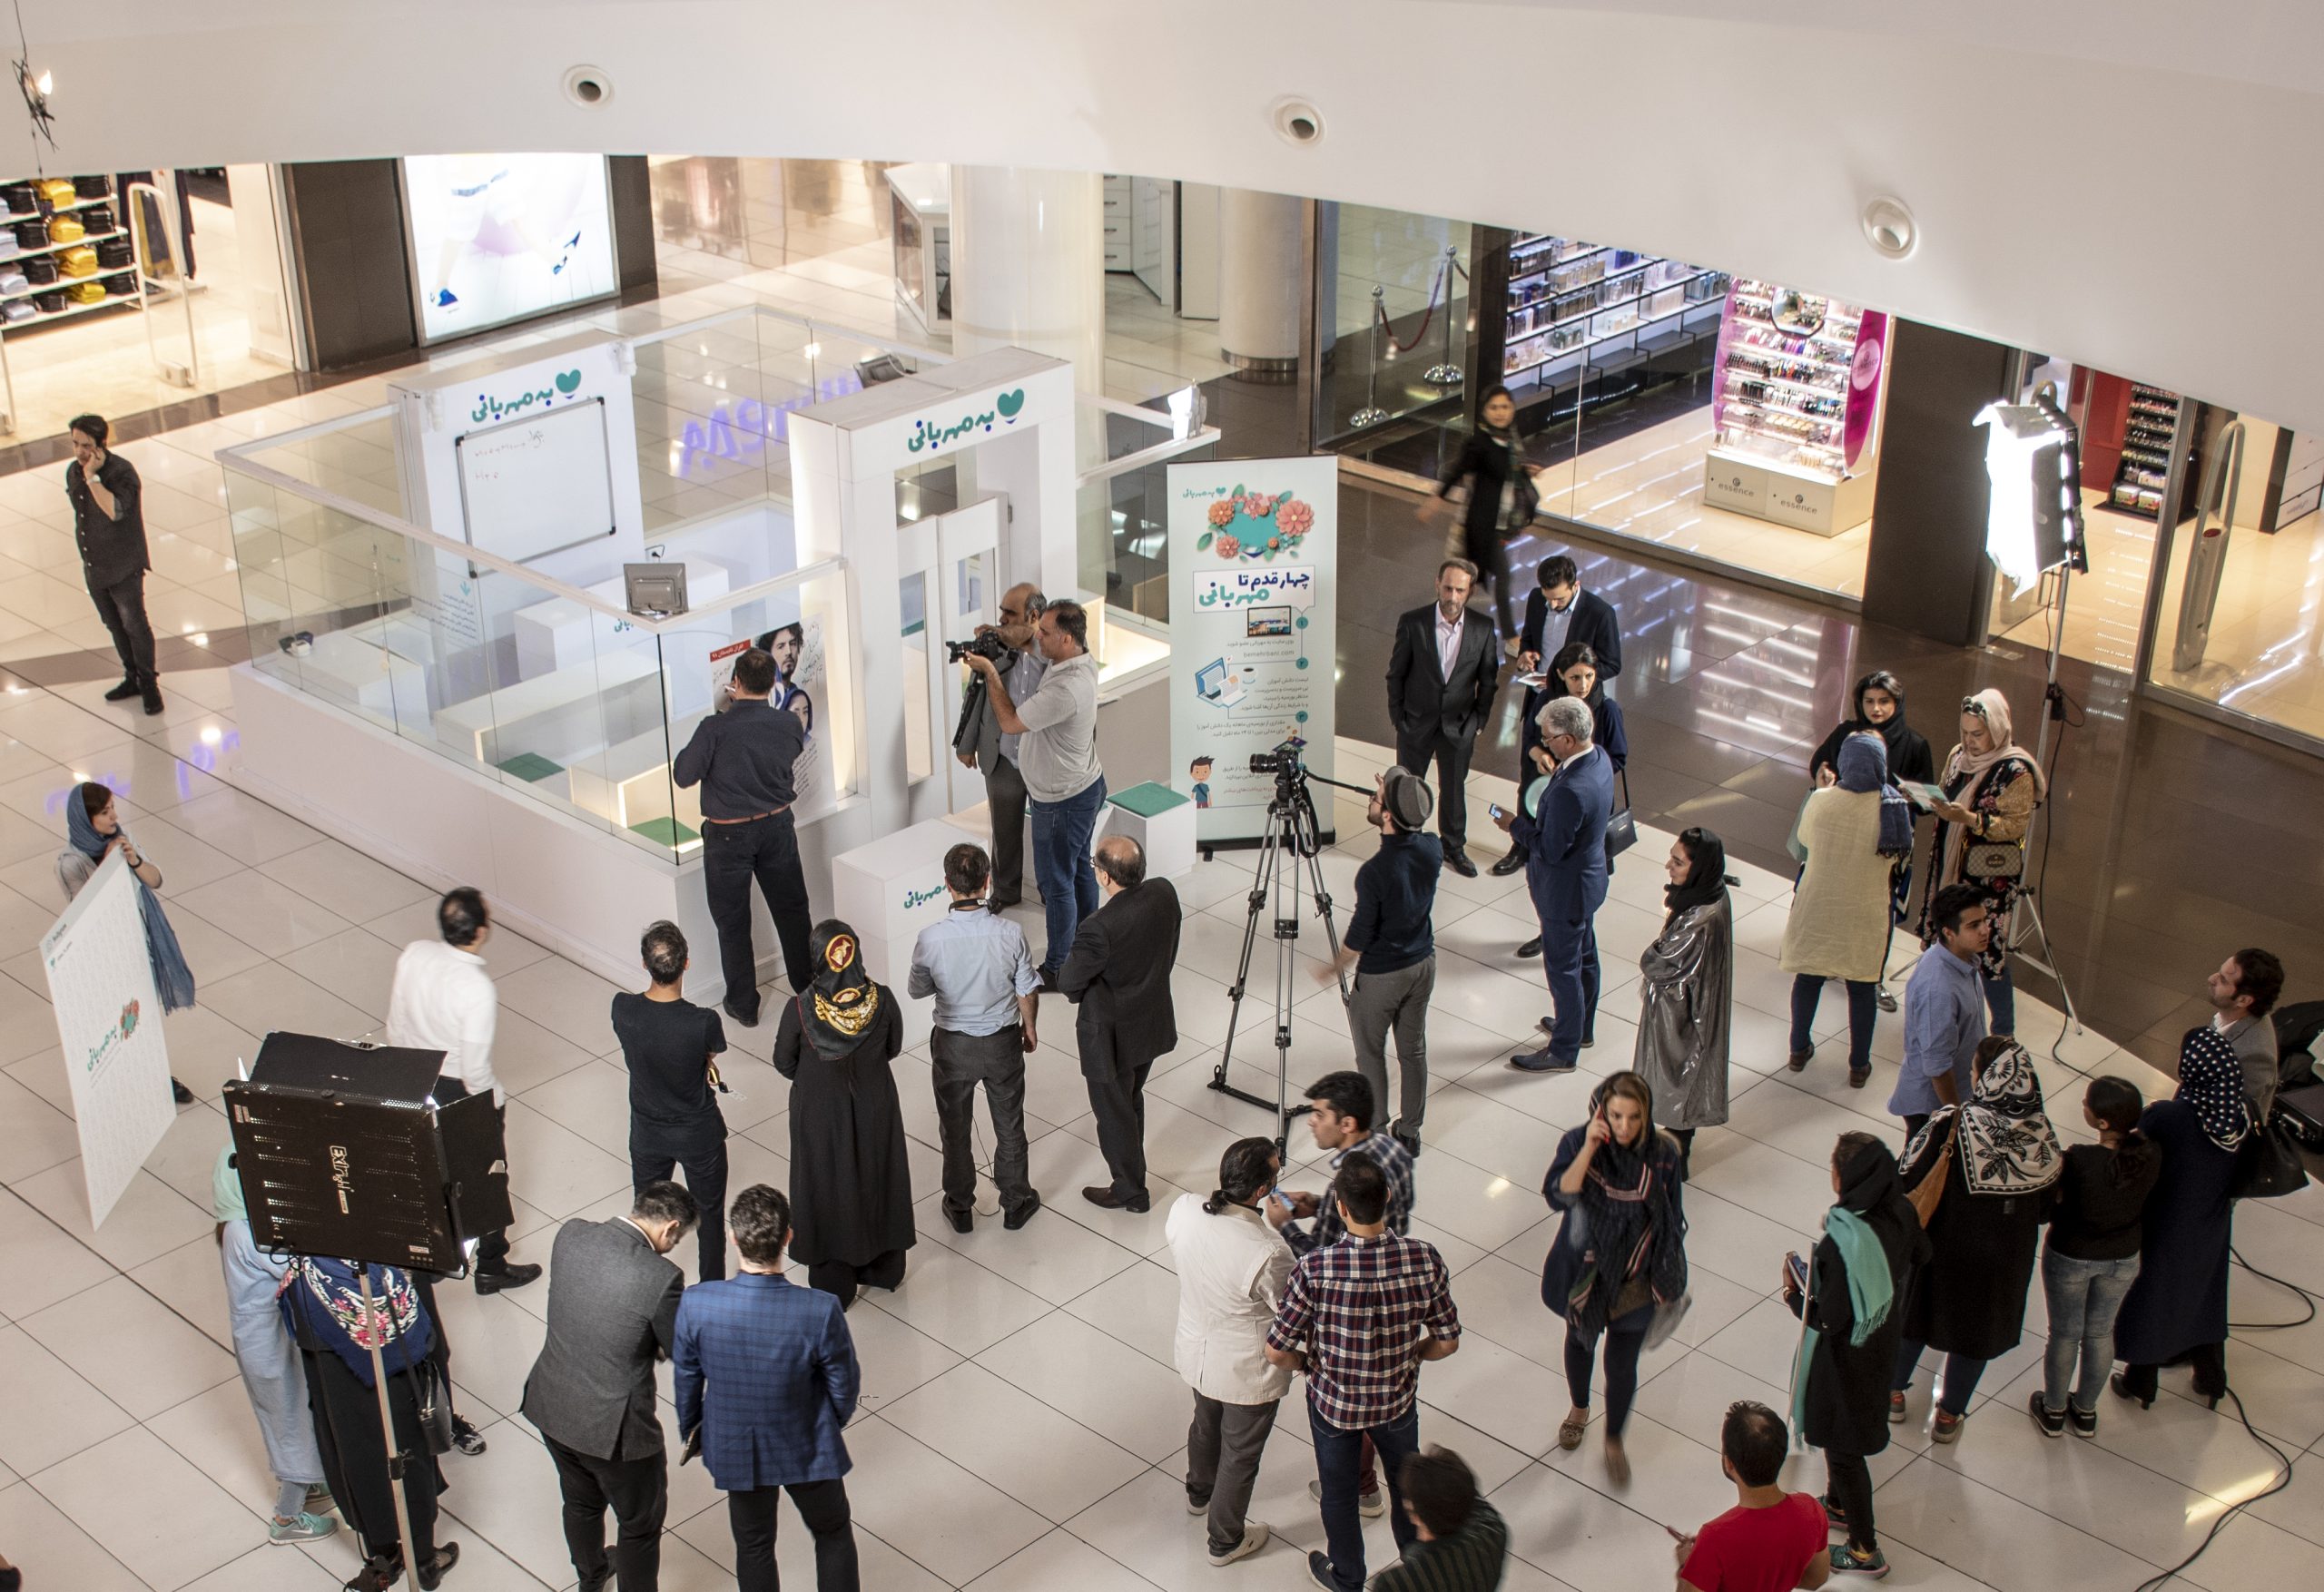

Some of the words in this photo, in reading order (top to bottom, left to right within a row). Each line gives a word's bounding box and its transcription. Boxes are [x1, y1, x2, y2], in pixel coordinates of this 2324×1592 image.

[472, 392, 534, 423] مهربانی
[908, 416, 974, 453] مهربانی
[1182, 488, 1207, 499] مهربانی
[1718, 483, 1755, 497] essence
[1780, 500, 1818, 515] essence
[1238, 575, 1248, 586] تا
[1251, 572, 1278, 592] قدم
[1279, 572, 1309, 589] چهار
[1198, 582, 1270, 608] مهربانی
[904, 886, 942, 909] مهربانی
